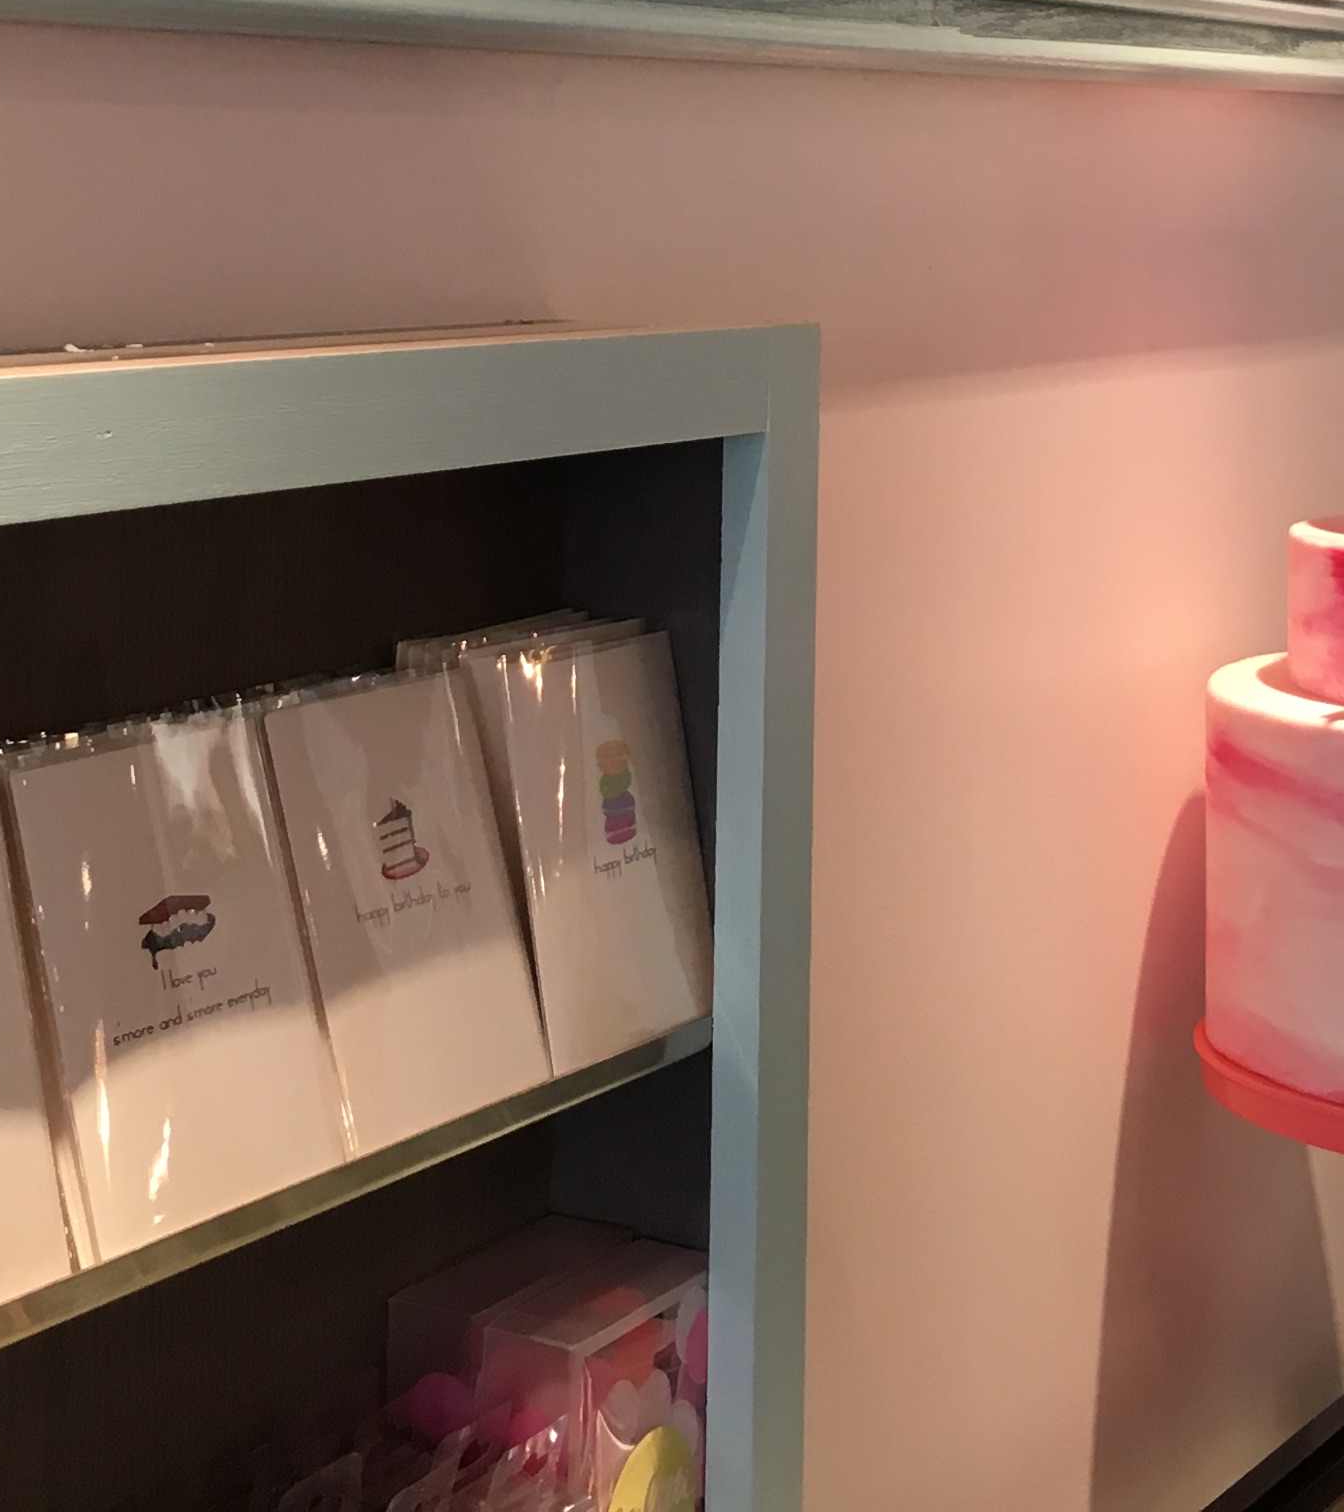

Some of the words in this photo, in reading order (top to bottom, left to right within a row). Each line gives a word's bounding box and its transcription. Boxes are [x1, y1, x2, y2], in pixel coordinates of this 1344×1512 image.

[593, 856, 622, 880] happy
[623, 840, 657, 865] birthday
[354, 903, 391, 930] happy
[391, 886, 436, 911] birthday
[437, 881, 450, 899] to
[160, 968, 167, 990] I
[169, 969, 193, 988] love
[197, 966, 218, 991] you
[158, 1004, 183, 1031] and
[226, 977, 272, 1010] everyday
